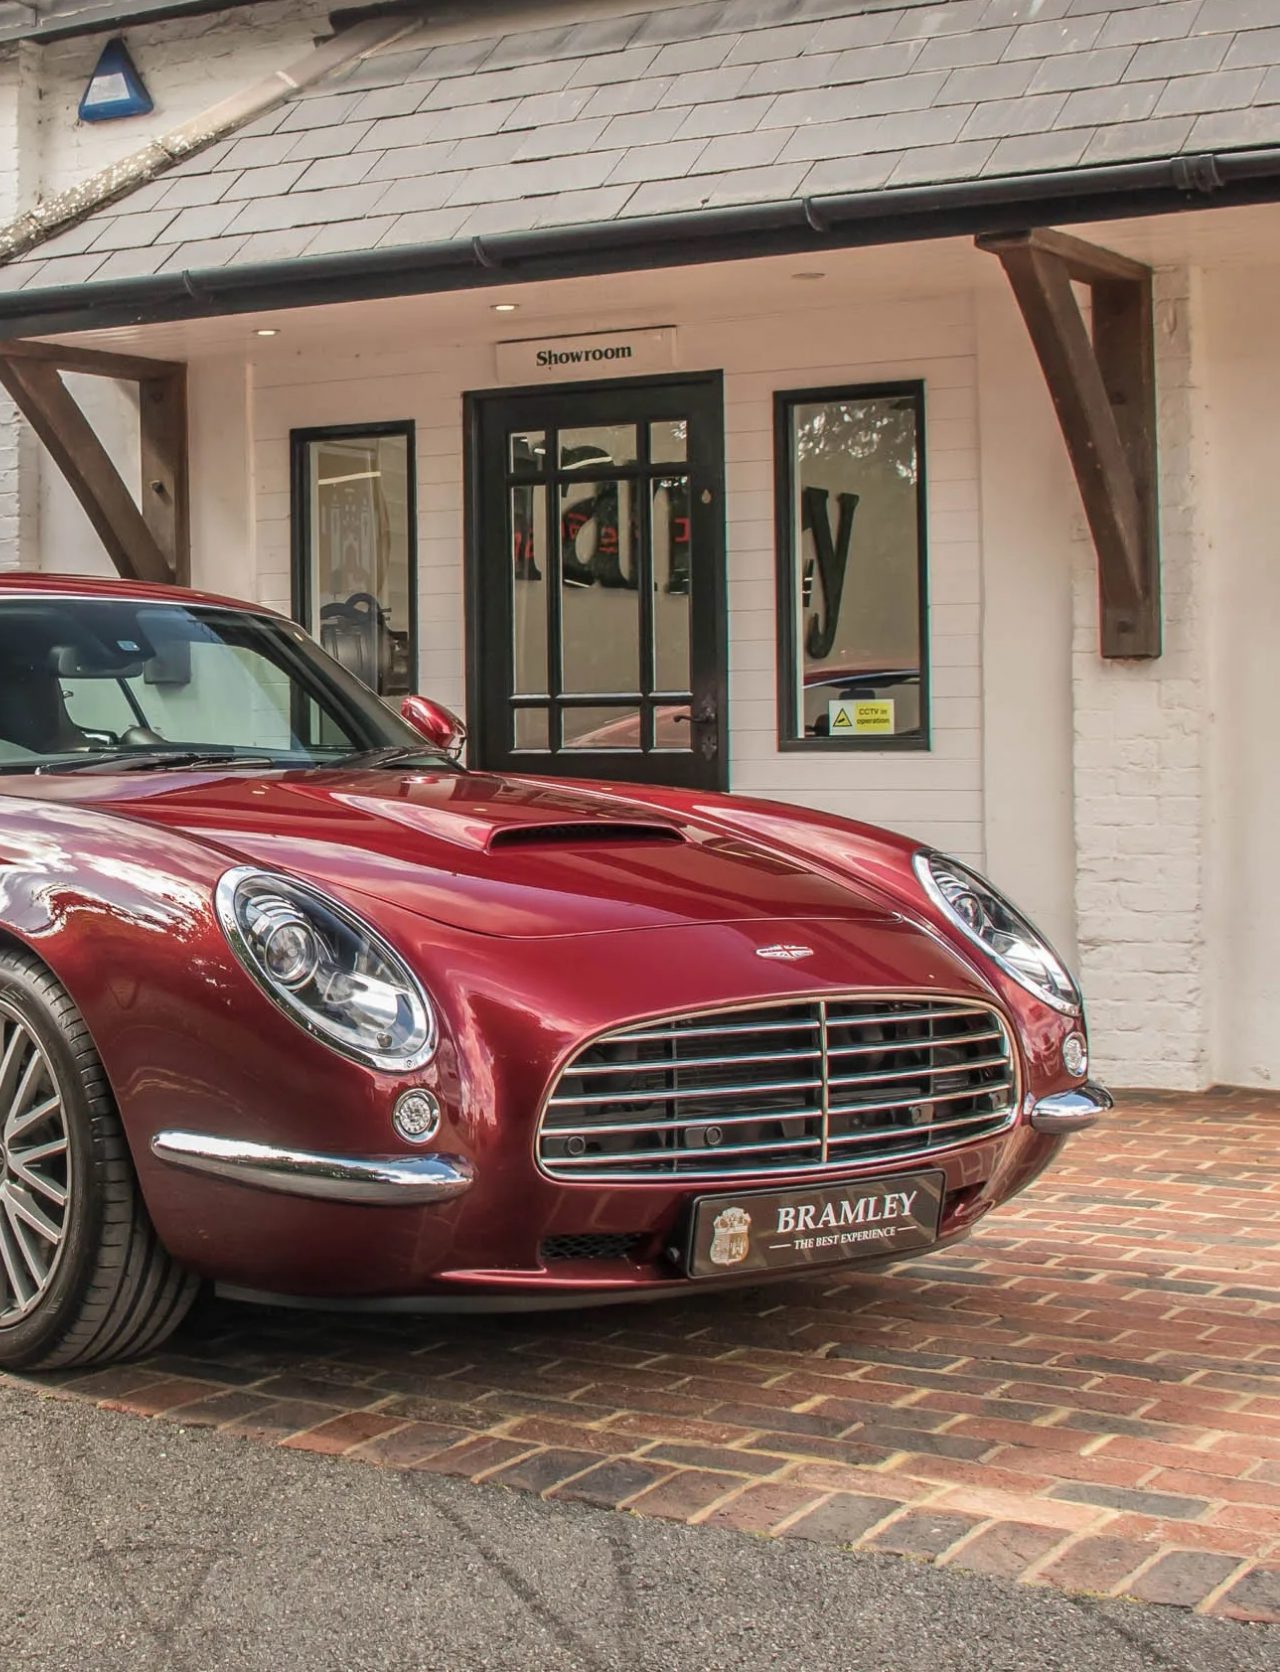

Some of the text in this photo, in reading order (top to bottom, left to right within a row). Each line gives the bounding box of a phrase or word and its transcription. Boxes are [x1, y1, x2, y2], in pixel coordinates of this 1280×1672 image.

[536, 346, 632, 367] Showroom
[858, 707, 879, 716] CCTV
[776, 1190, 918, 1233] BRAMLEY
[793, 1226, 897, 1250] THE BEST EXPERIENCE
